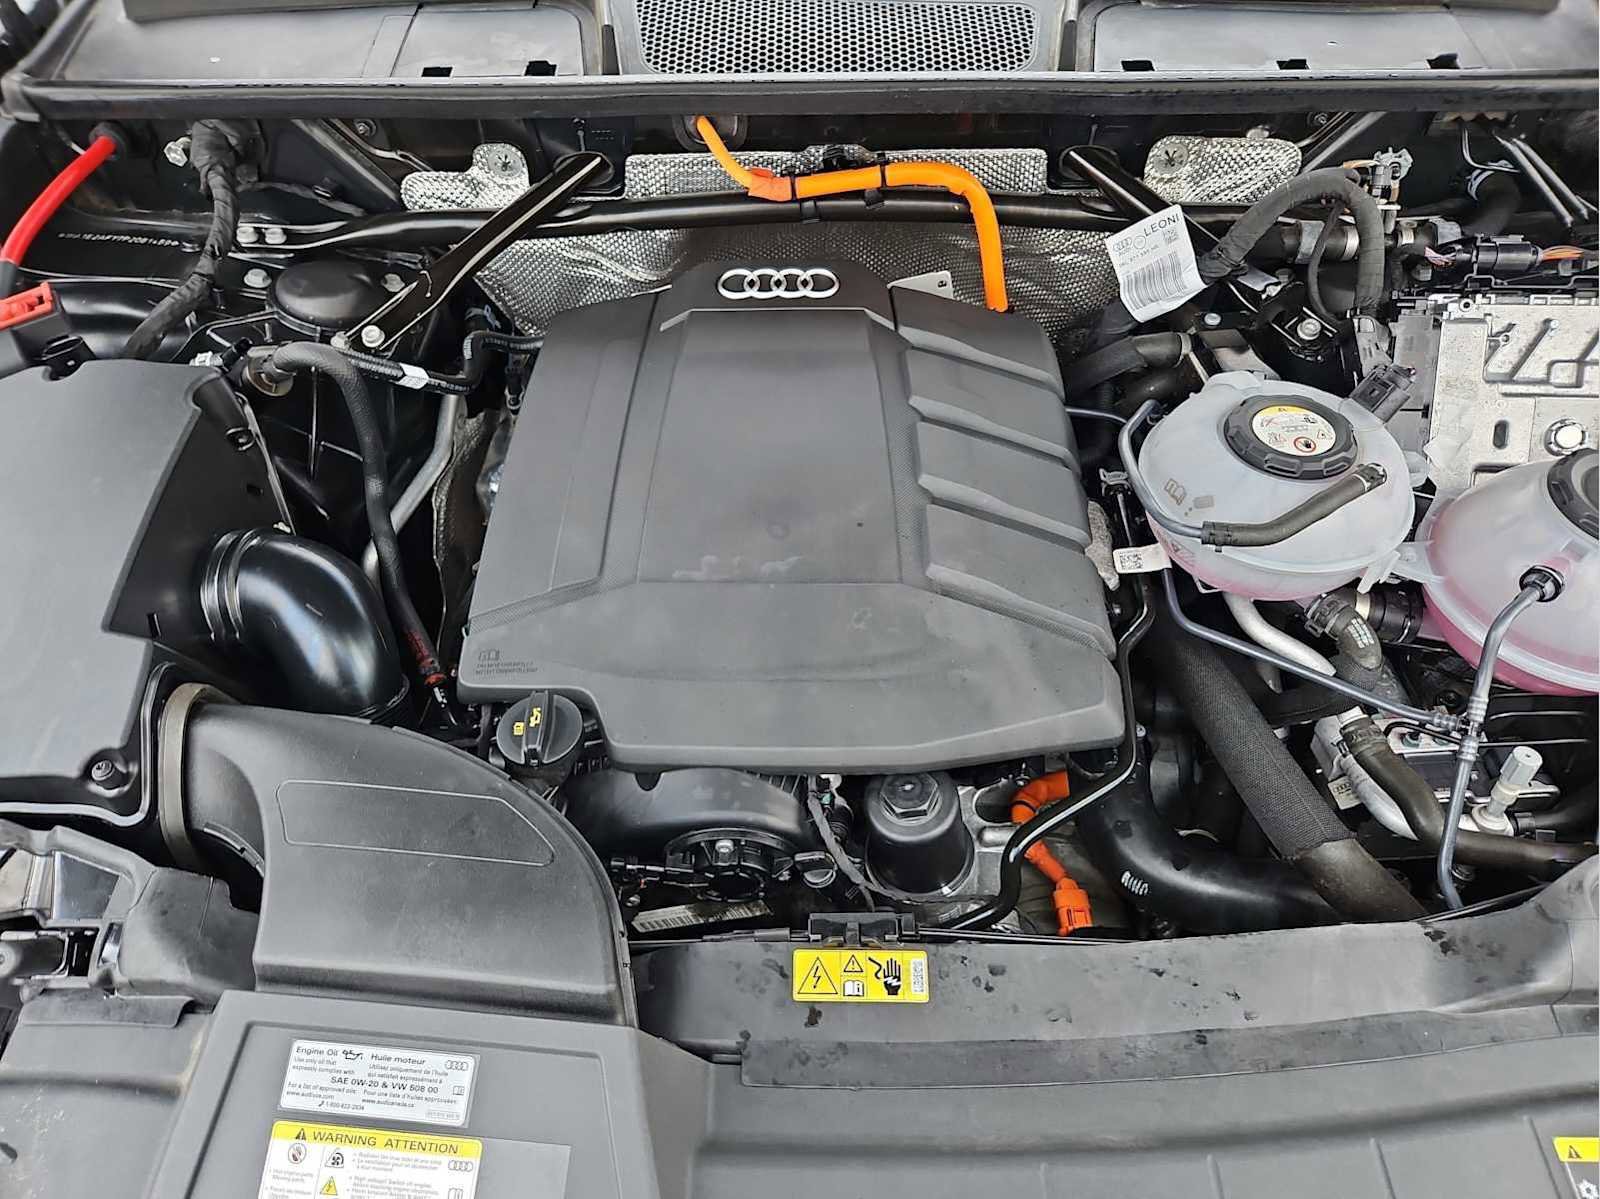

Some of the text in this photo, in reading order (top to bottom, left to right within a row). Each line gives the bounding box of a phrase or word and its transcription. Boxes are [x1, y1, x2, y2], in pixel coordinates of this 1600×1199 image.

[1143, 213, 1181, 237] LEONI
[296, 1046, 339, 1057] Engine Oil
[371, 1053, 426, 1065] Huile moteur
[330, 1076, 439, 1094] SAE 0W-20 & VW 508 00
[312, 1131, 459, 1155] WARNING ATTENTION
